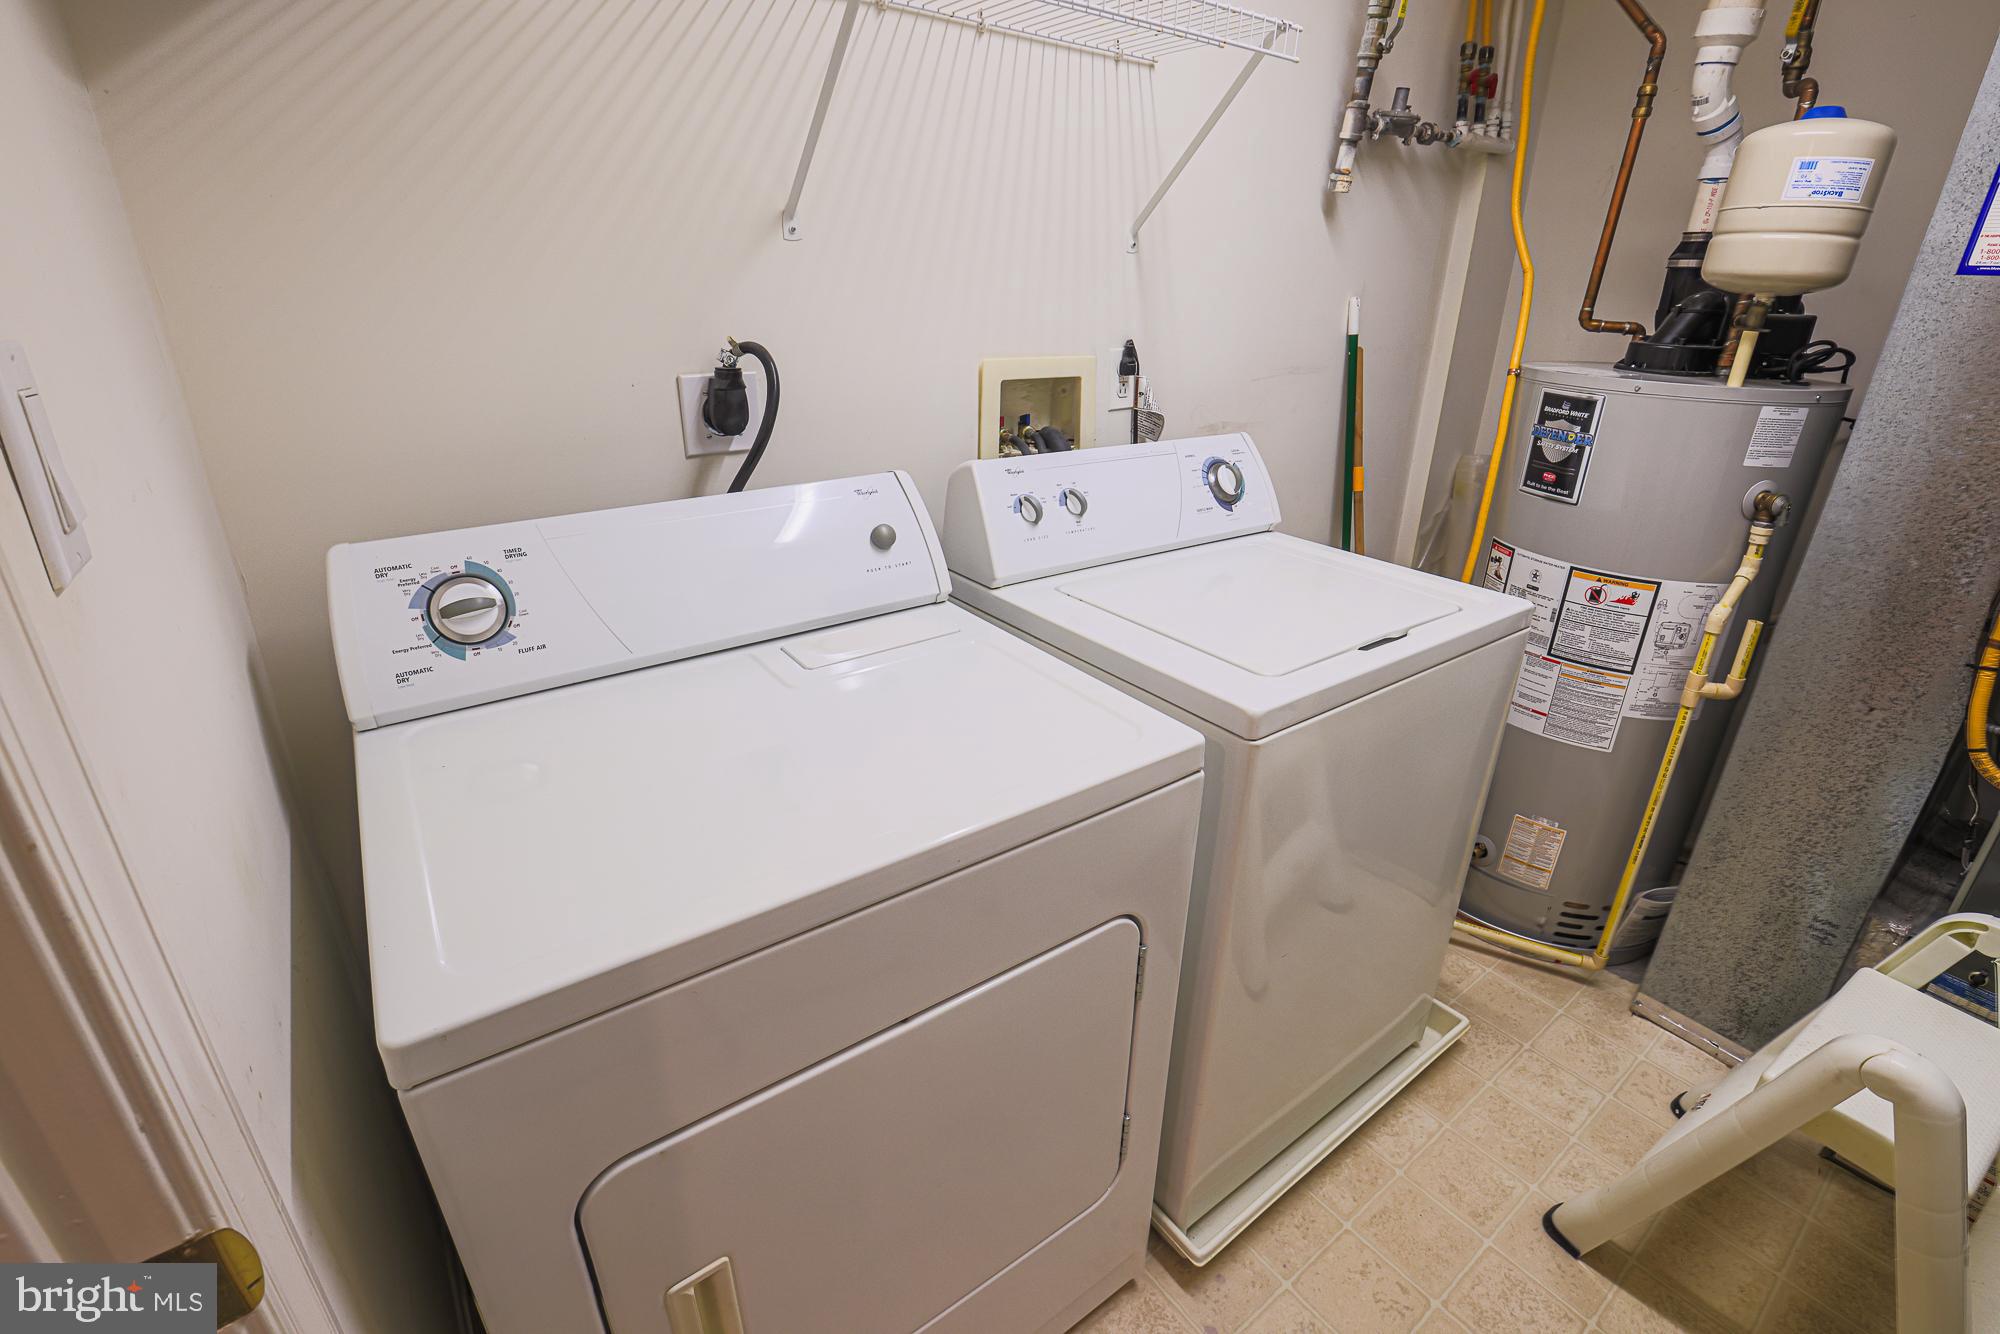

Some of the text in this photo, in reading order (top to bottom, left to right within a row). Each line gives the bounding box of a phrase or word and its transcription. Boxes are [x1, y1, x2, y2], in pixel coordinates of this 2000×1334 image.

[1531, 424, 1595, 447] DEFENDER
[503, 547, 522, 555] TIMED
[504, 551, 528, 560] DRYING
[374, 563, 413, 574] AUTOMATIC
[375, 572, 389, 580] DRY
[1603, 579, 1629, 588] WARNING
[391, 643, 433, 655] Energy Preferred
[518, 643, 547, 655] FLUFF AIR
[395, 666, 434, 679] AUTOMATIC
[396, 677, 410, 685] DRY
